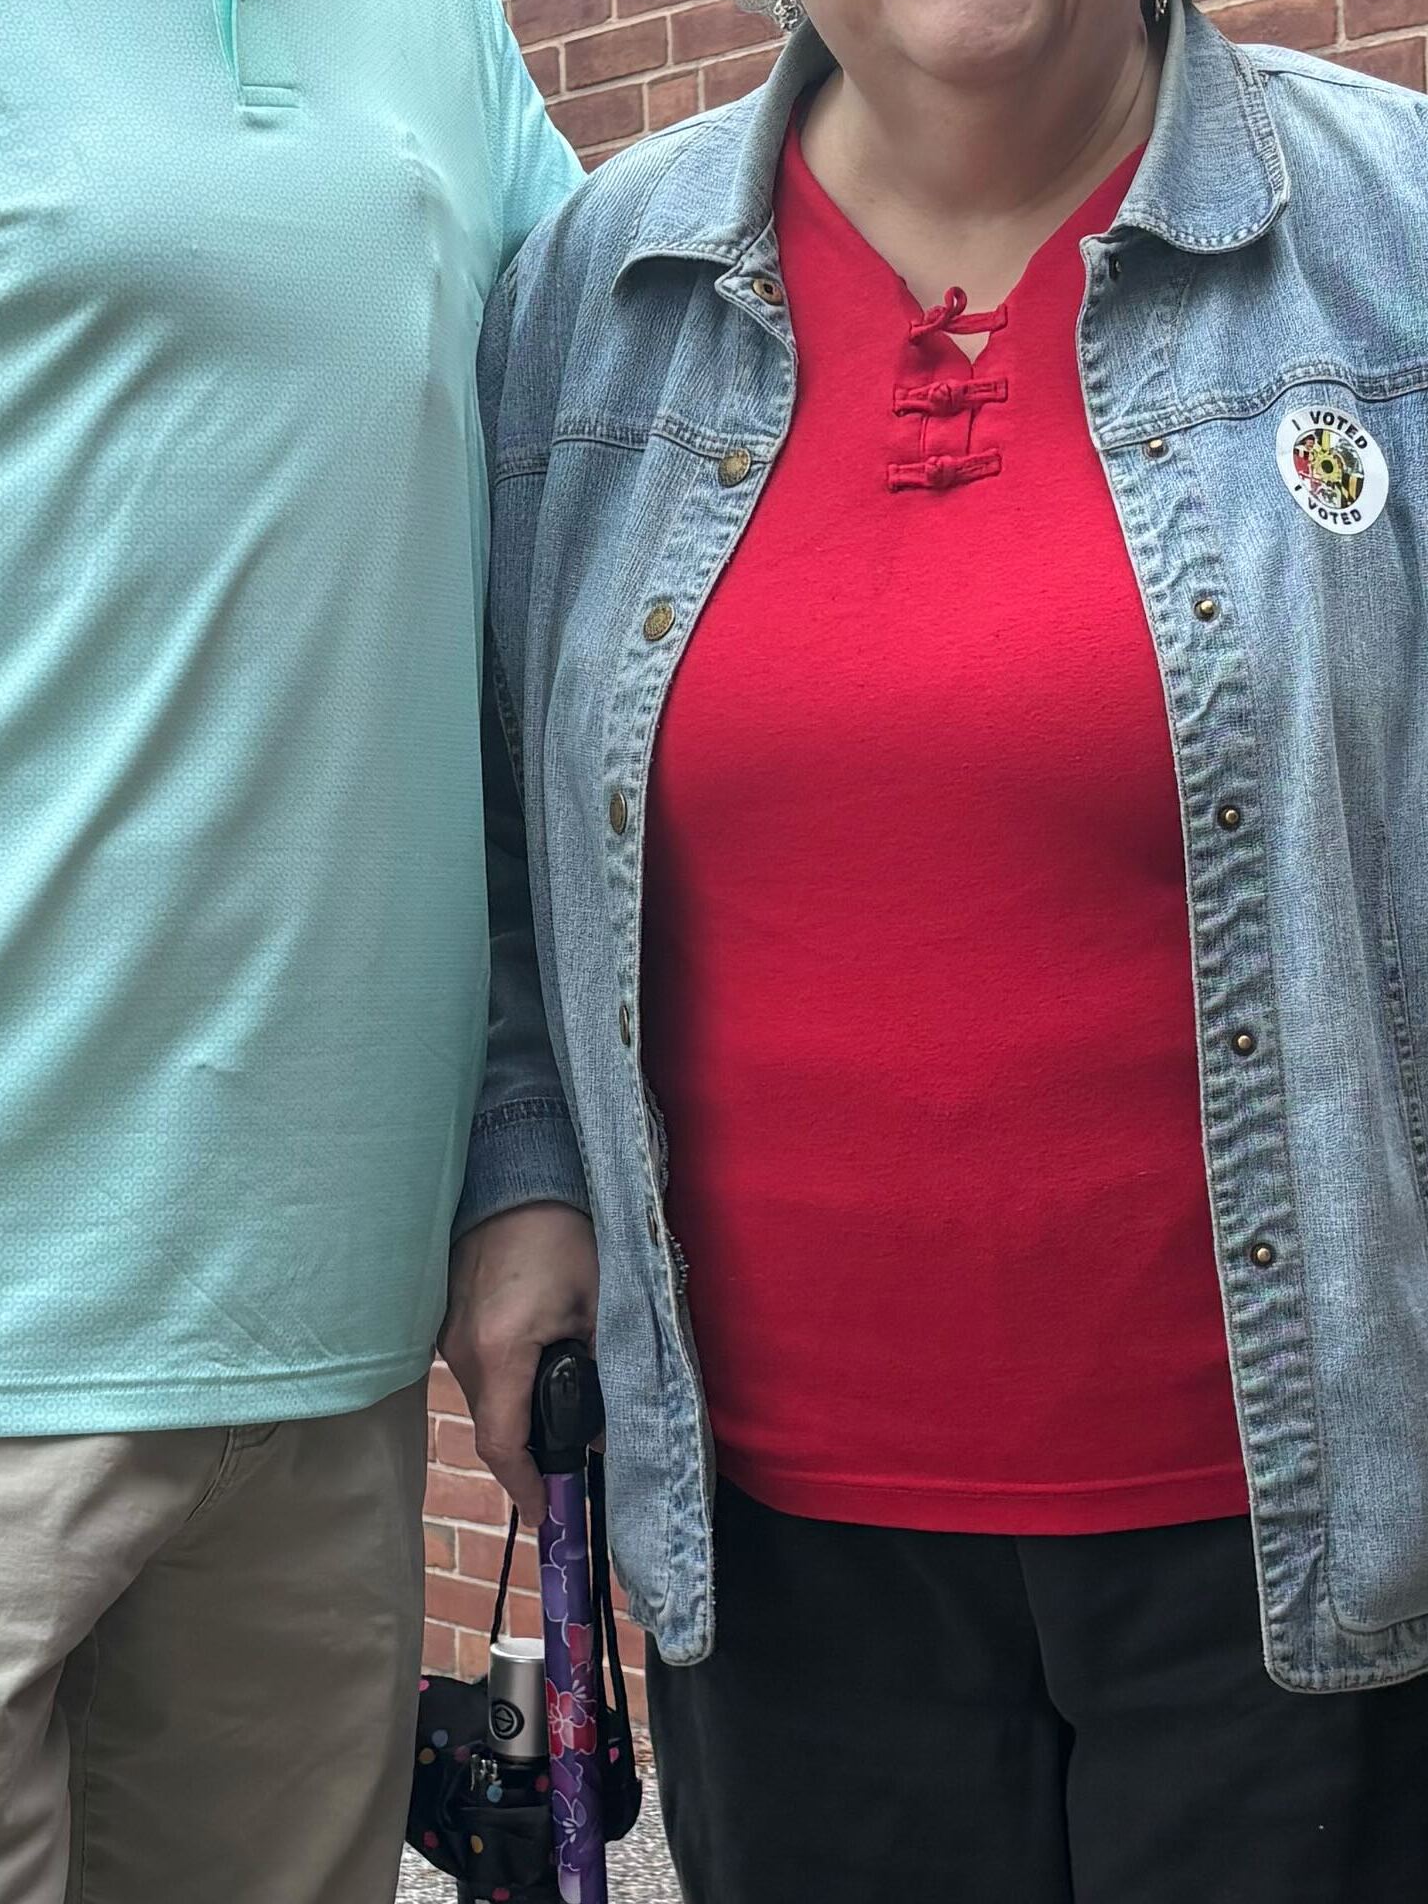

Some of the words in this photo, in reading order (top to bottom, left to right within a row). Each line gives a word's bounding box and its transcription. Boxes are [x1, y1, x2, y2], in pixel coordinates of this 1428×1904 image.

[1292, 419, 1300, 430] I
[1310, 411, 1367, 449] VOTED
[1308, 497, 1361, 525] VOTED
